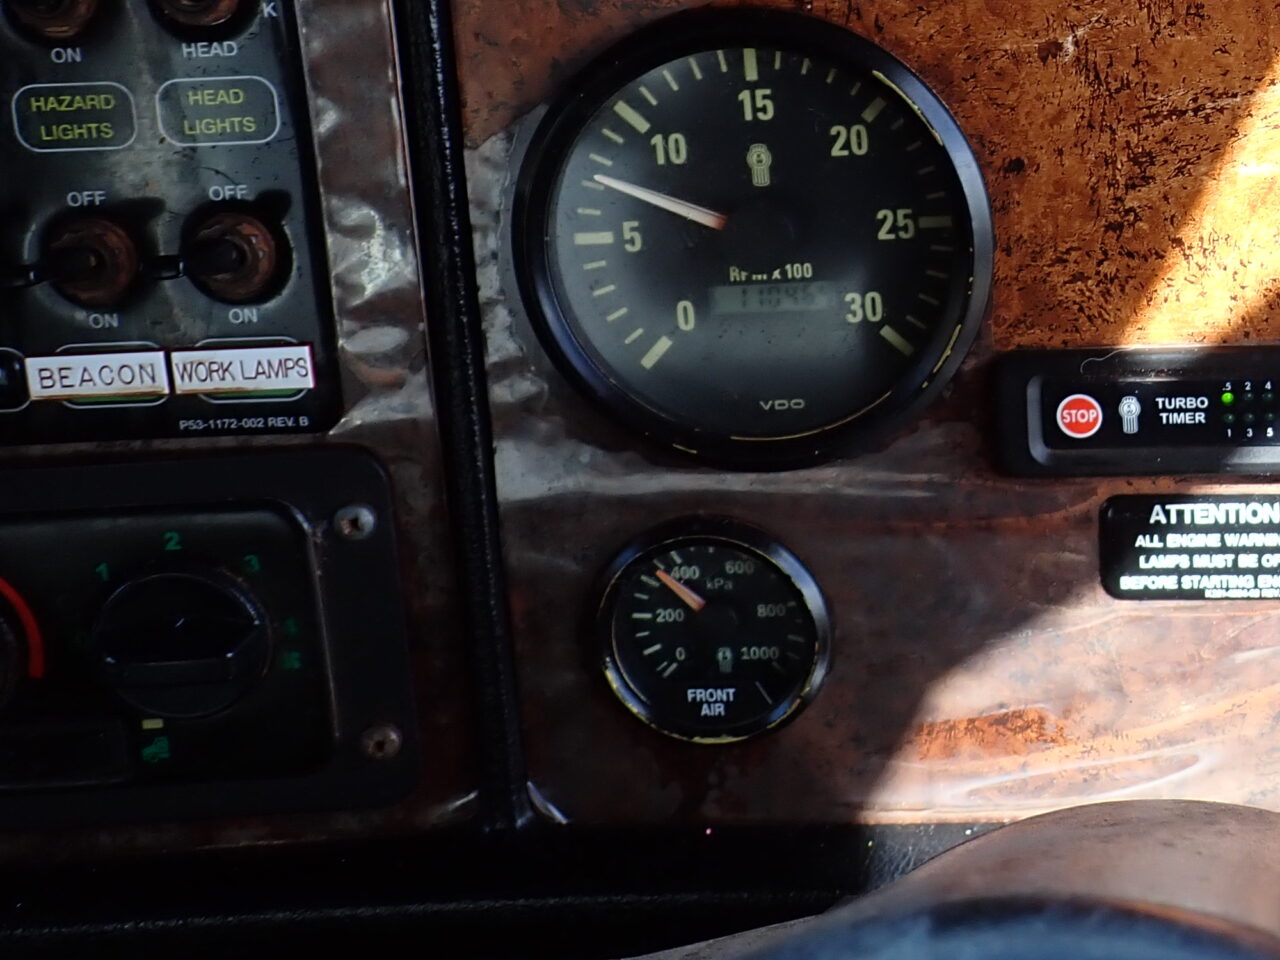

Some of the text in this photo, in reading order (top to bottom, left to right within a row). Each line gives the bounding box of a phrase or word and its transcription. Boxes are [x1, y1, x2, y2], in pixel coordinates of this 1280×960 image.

[51, 47, 82, 63] ON
[182, 41, 238, 58] HEAD
[31, 94, 115, 112] HAZARD
[188, 89, 244, 105] HEAD
[737, 88, 775, 122] 15
[40, 123, 114, 141] LIGHTS
[184, 117, 256, 135] LIGHTS
[829, 124, 869, 157] 20
[650, 133, 688, 166] 10
[67, 191, 107, 208] OFF
[208, 185, 248, 202] OFF
[875, 209, 916, 241] 25
[622, 220, 643, 253] 5
[785, 263, 813, 279] 100
[228, 308, 258, 324] ON
[676, 300, 696, 332] 0
[843, 292, 883, 324] 30
[89, 312, 119, 330] ON
[38, 363, 157, 390] BEACON
[175, 357, 309, 383] WORK LAMPS
[1244, 381, 1251, 390] 2
[1265, 381, 1272, 390] 4
[760, 397, 806, 412] VDO
[1155, 397, 1209, 410] TURBO
[179, 416, 309, 431] P53-1172-002 REV. B
[1062, 409, 1098, 424] STOP
[1159, 412, 1206, 425] TIMER
[1227, 428, 1232, 438] 1
[1246, 428, 1253, 438] 3
[1266, 427, 1274, 438] 5
[1150, 502, 1280, 525] ATTENTION
[163, 531, 183, 551] 2
[1135, 534, 1164, 548] ALL
[1166, 533, 1221, 548] ENGINE
[243, 554, 262, 574] 3
[725, 561, 755, 575] 600
[1139, 554, 1190, 569] LAMPS
[1192, 554, 1235, 568] MUST
[1237, 554, 1259, 568] BE
[95, 562, 110, 582] 1
[670, 565, 700, 581] 400
[706, 579, 733, 591] kPa
[1119, 575, 1178, 590] BEFORE
[1180, 574, 1255, 589] STARTING
[656, 608, 684, 623] 200
[757, 603, 786, 617] 800
[676, 647, 686, 661] 0
[741, 646, 780, 661] 1000
[687, 688, 736, 703] FRONT
[700, 703, 726, 716] AIR
